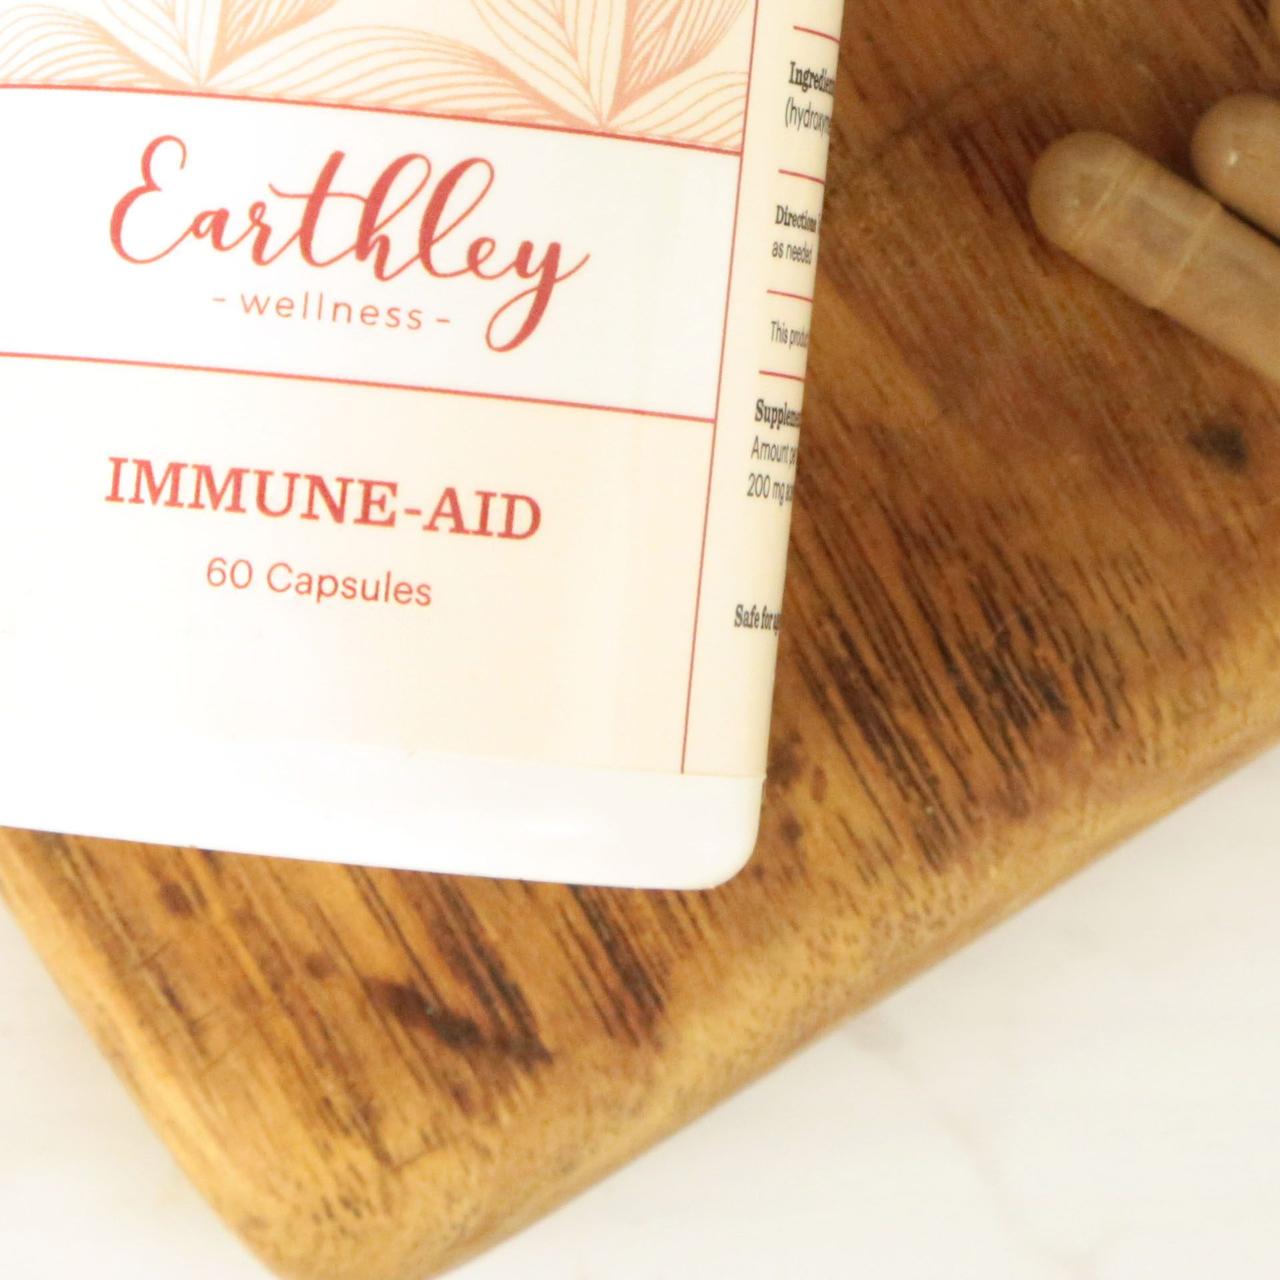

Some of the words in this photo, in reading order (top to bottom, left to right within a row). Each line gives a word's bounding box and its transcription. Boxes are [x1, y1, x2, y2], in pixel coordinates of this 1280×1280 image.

[109, 133, 591, 354] Earthley
[771, 240, 784, 258] as
[770, 320, 788, 345] This
[751, 435, 788, 463] Amount
[105, 455, 543, 542] IMMUNE-AID
[746, 472, 771, 499] 200
[772, 480, 785, 506] mg
[205, 556, 254, 590] 60
[266, 561, 433, 608] Capsules
[734, 604, 760, 629] Safe
[760, 605, 773, 631] for
